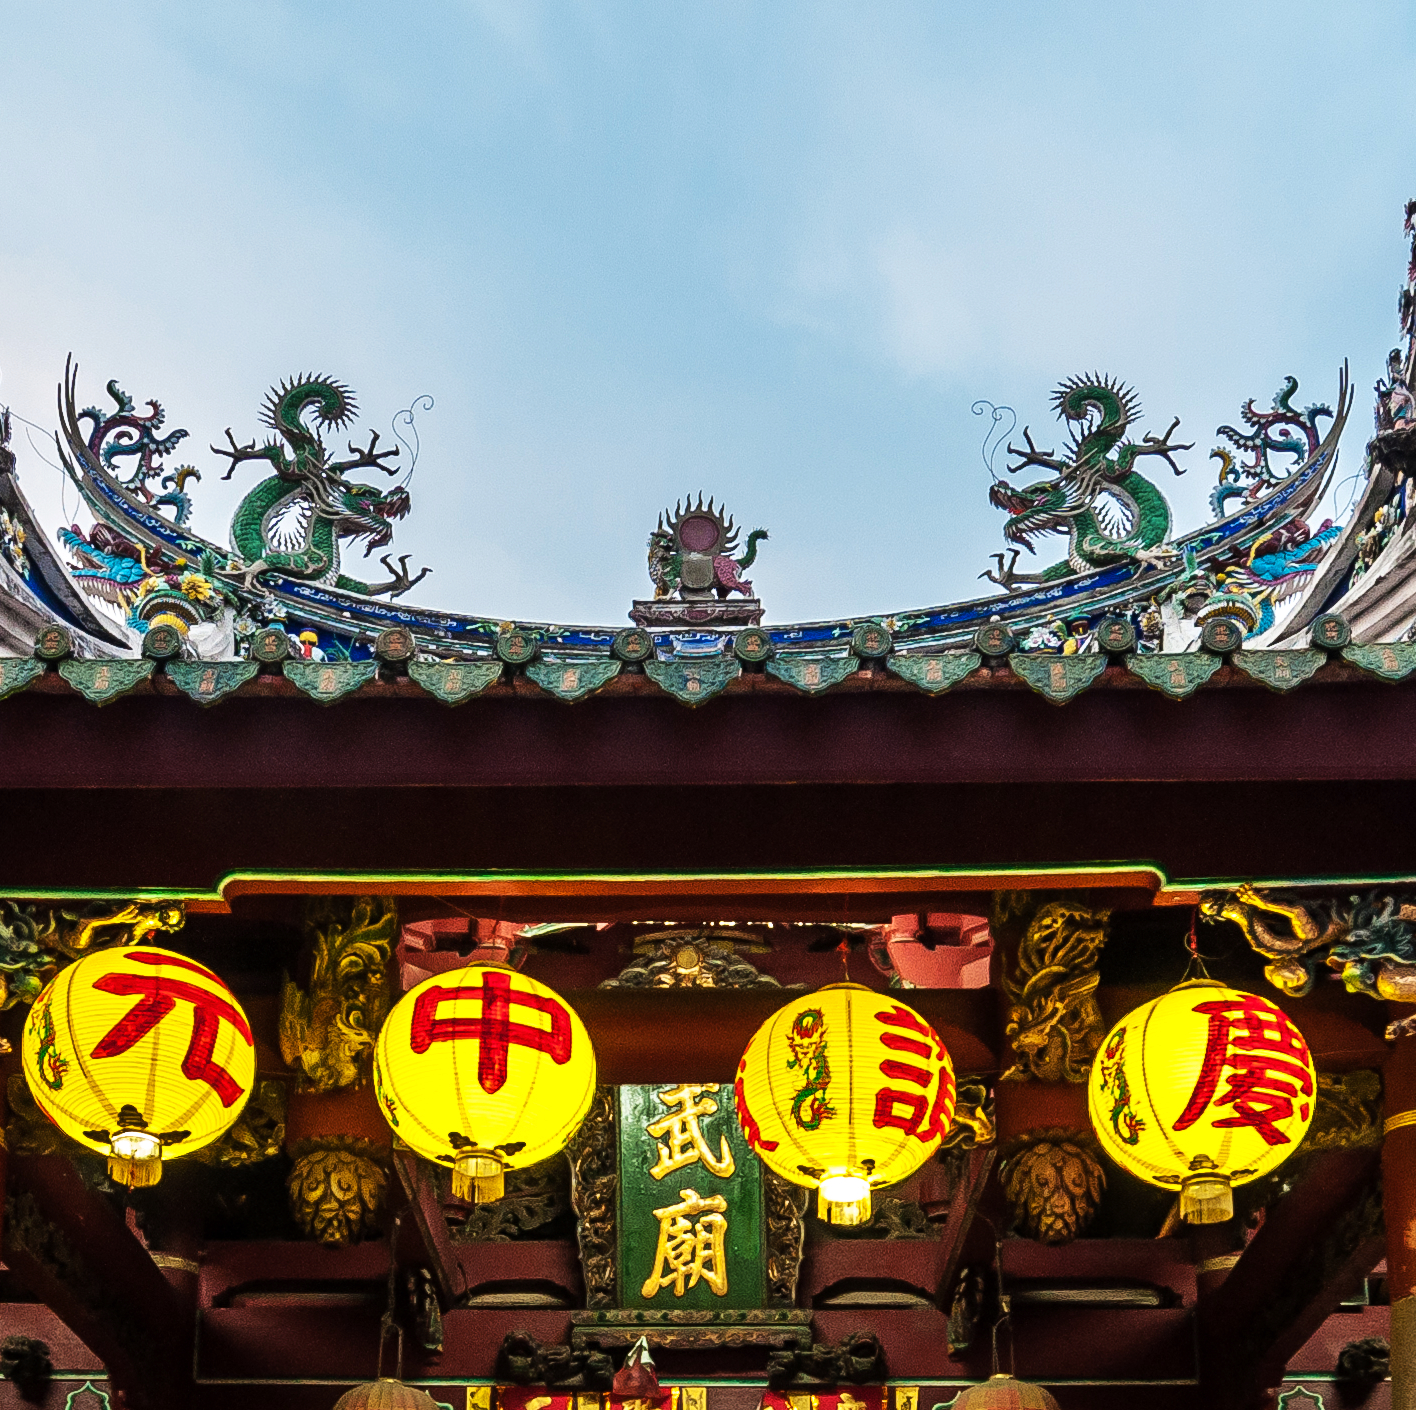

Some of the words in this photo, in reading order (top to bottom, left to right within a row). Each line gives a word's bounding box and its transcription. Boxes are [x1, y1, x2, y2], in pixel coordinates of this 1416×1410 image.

[90, 950, 255, 1109] 元
[410, 971, 573, 1095] 中
[1172, 994, 1316, 1147] 慶
[641, 1083, 736, 1299] 武廟
